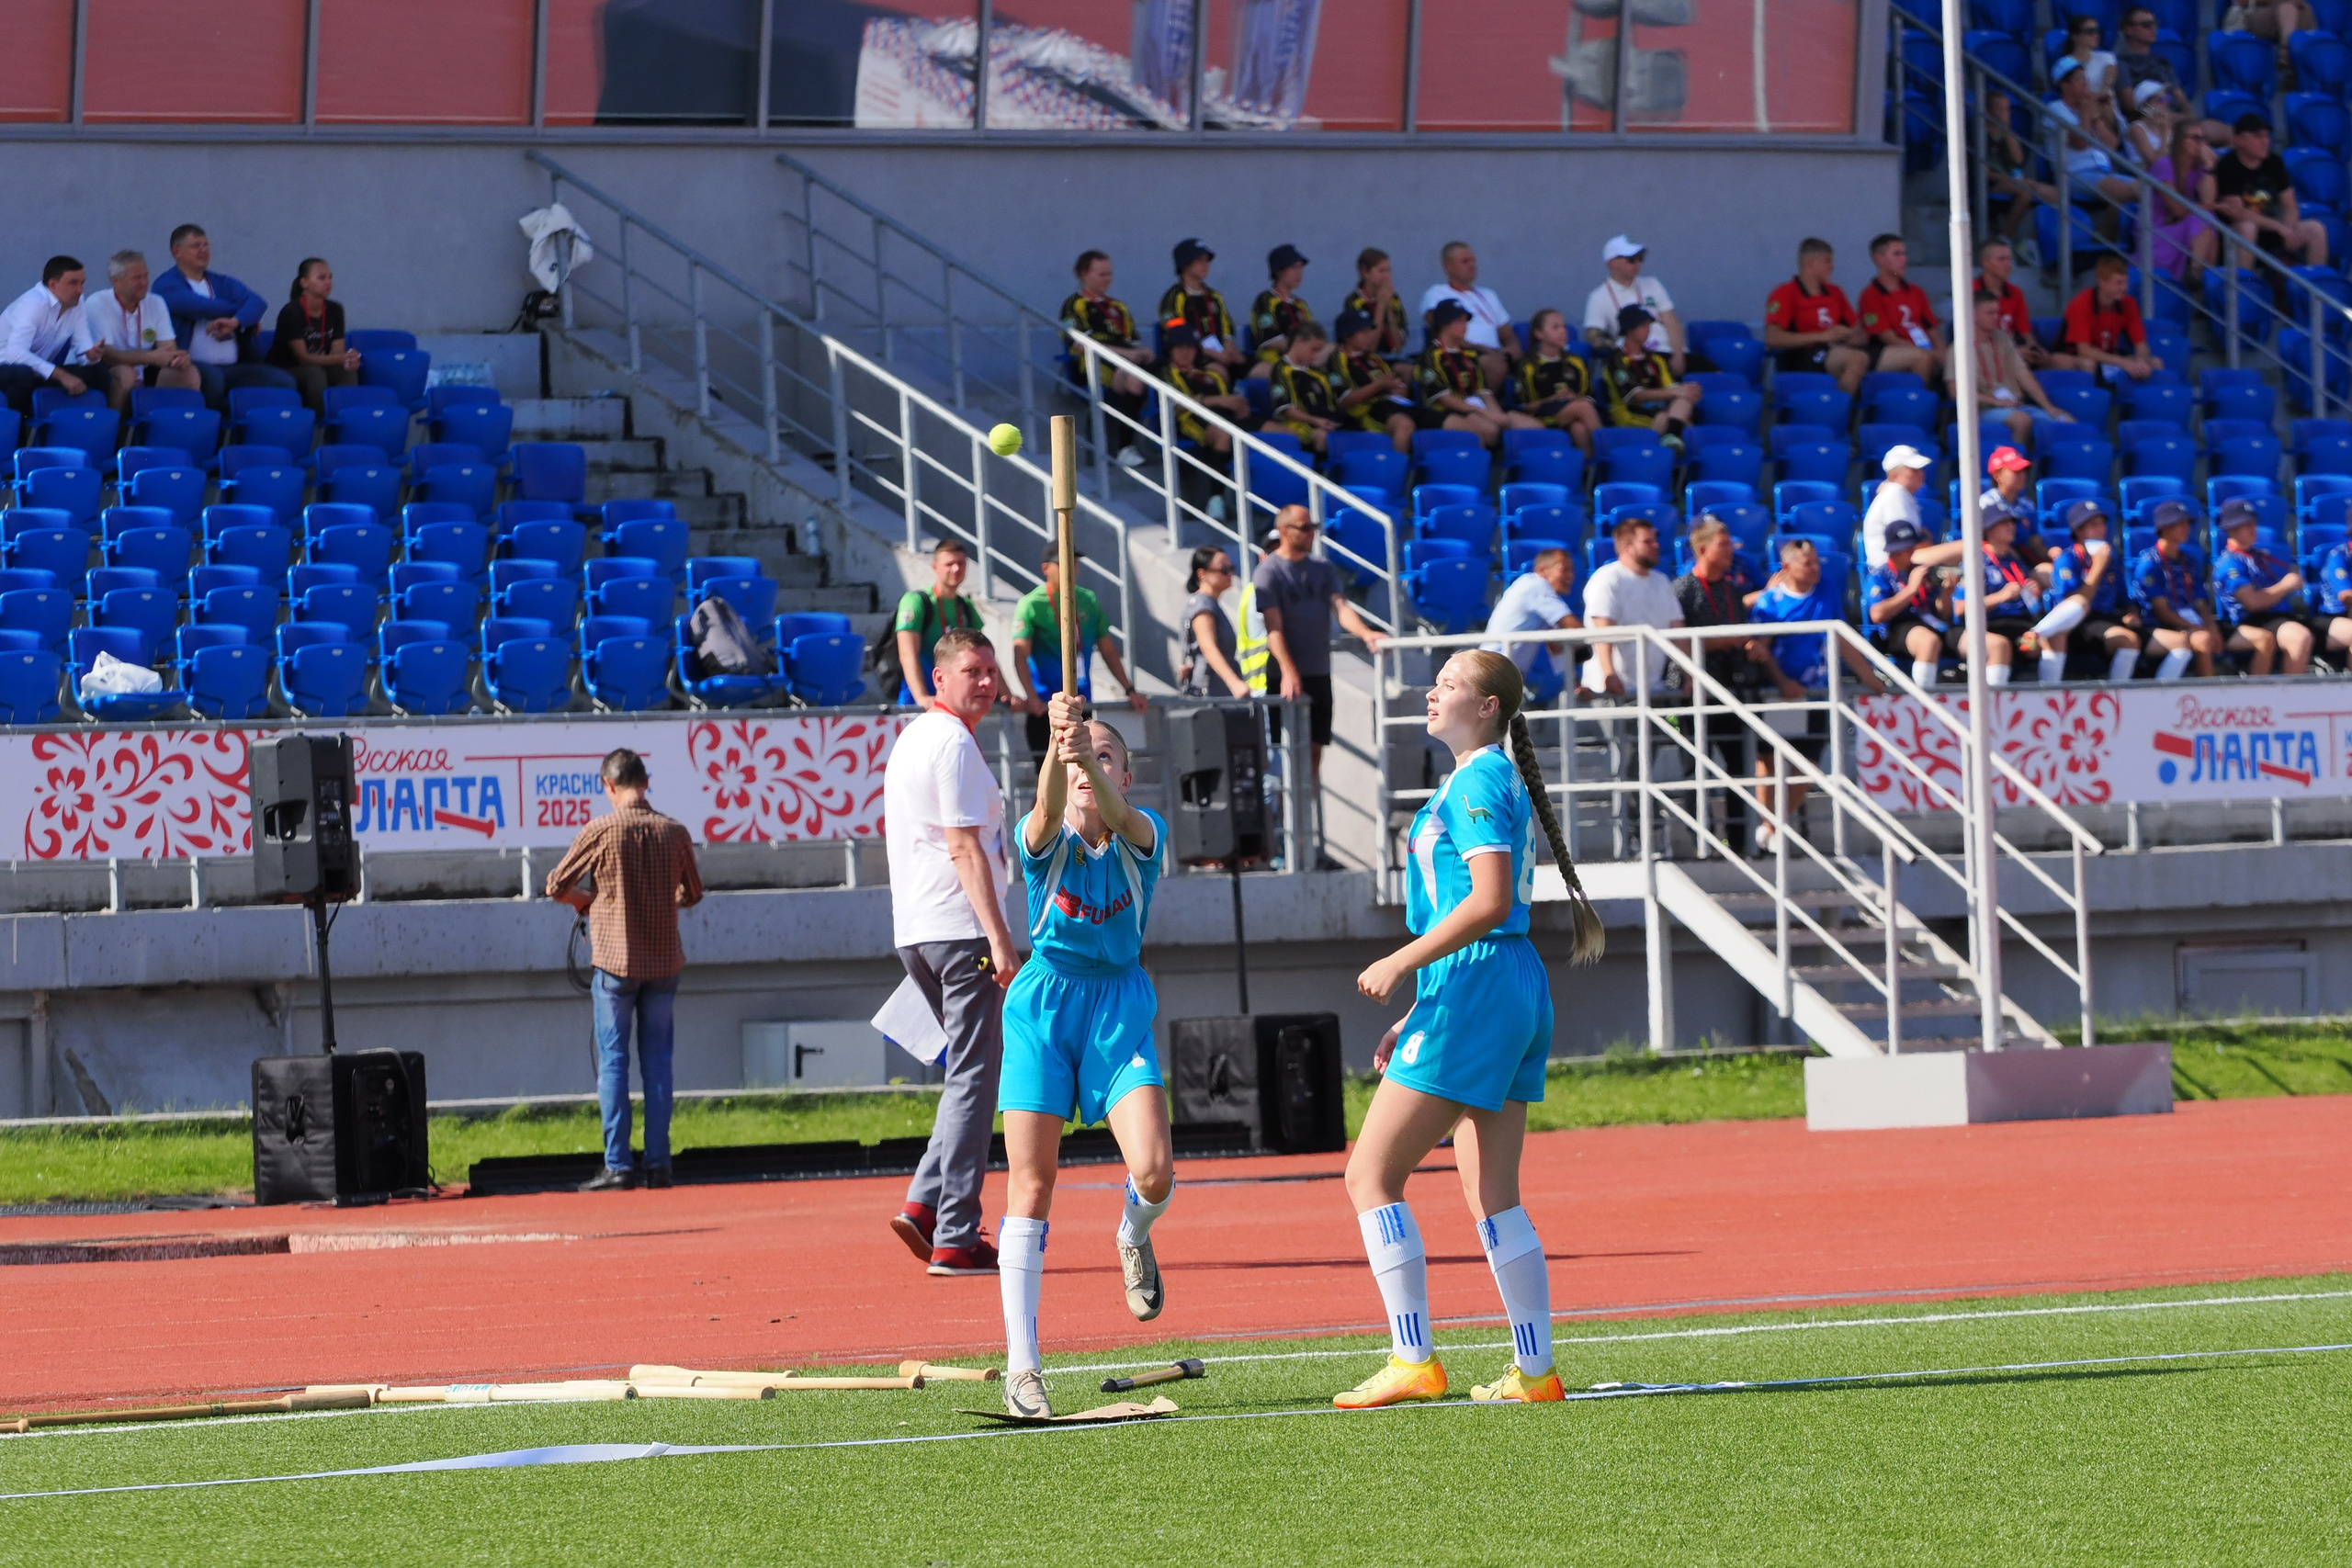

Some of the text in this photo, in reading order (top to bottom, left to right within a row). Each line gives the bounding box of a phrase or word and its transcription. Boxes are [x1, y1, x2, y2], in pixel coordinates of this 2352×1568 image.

[2190, 731, 2319, 783] ЛАПТА
[537, 773, 652, 796] КРАСНО
[355, 775, 505, 832] ЛАПТА
[537, 799, 591, 828] 2025
[1401, 1030, 1425, 1065] 8
